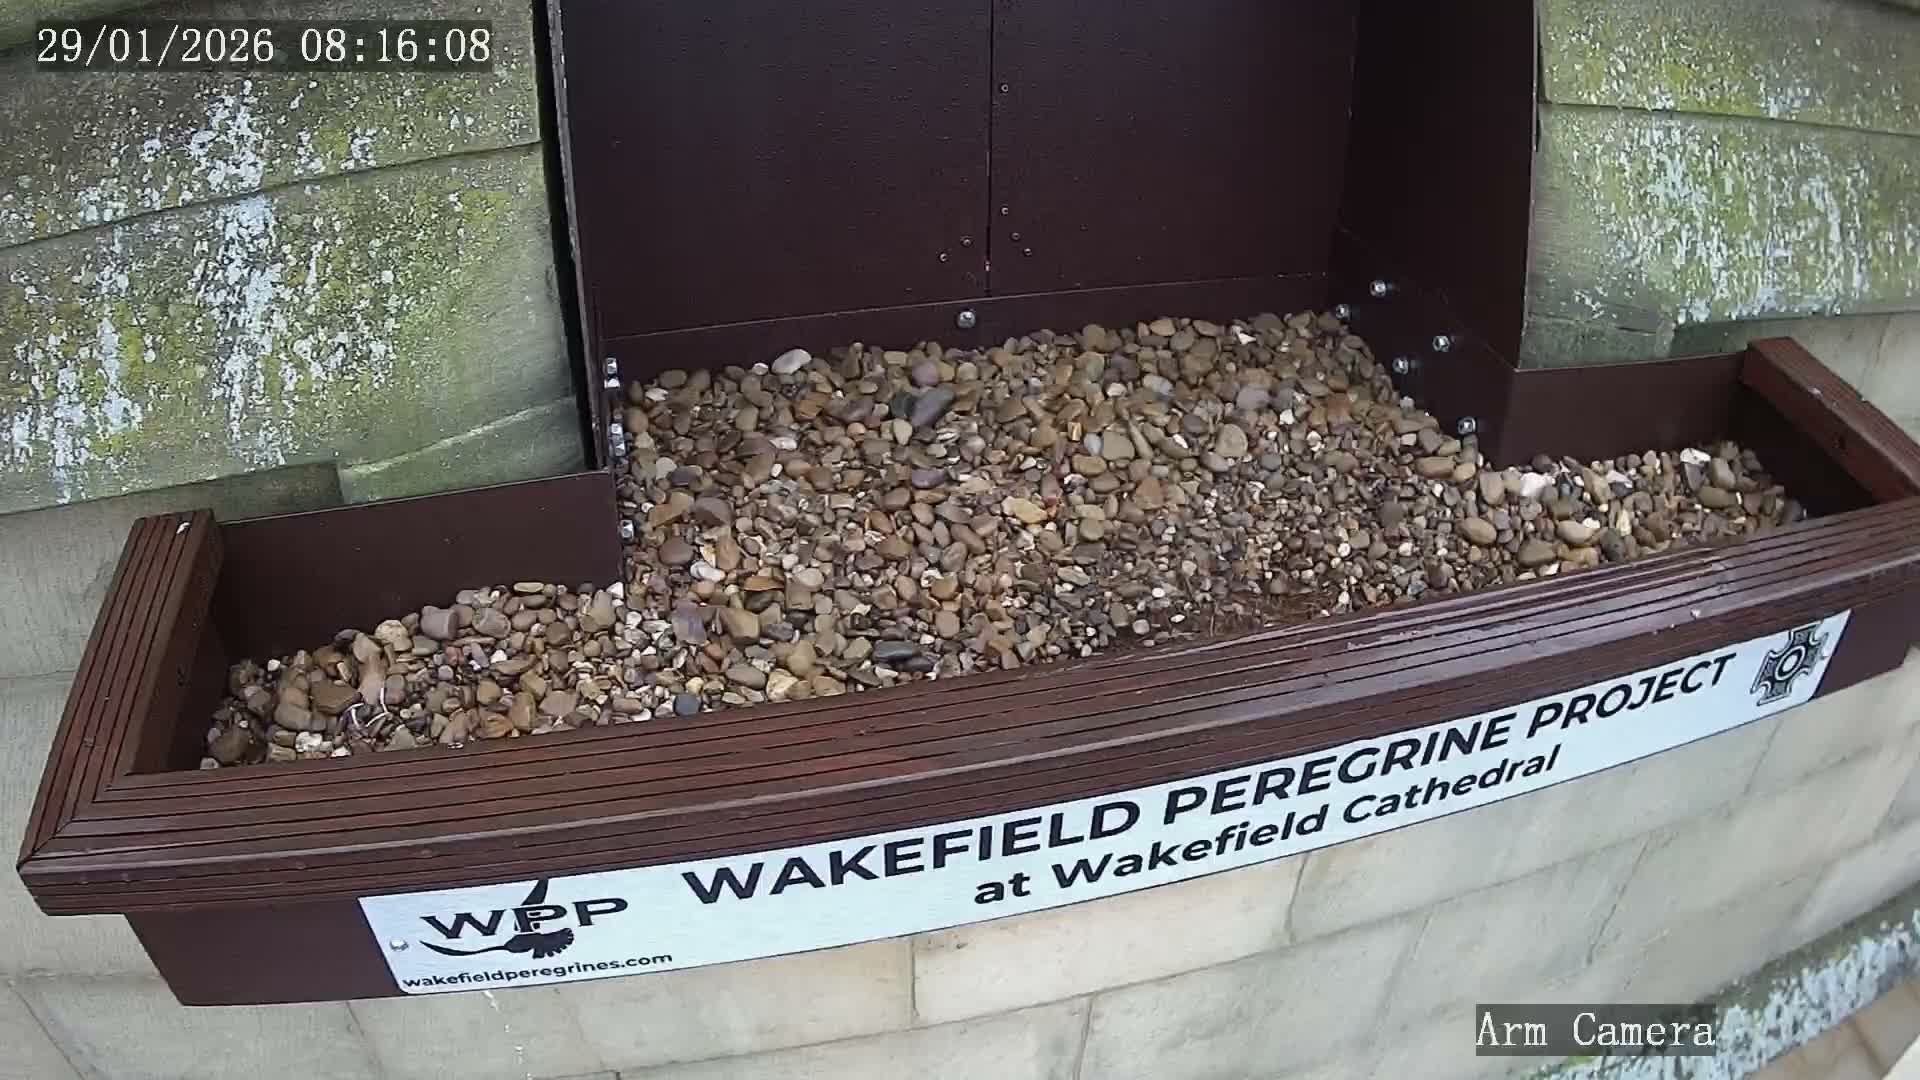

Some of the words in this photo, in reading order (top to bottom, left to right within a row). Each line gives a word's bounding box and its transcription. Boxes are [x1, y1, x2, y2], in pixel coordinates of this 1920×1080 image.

[682, 800, 1141, 905] WAKEFIELD
[1163, 712, 1517, 825] PEREGRINE
[1527, 652, 1737, 739] PROJECT
[974, 871, 1031, 905] at
[1051, 804, 1329, 889] Wakefield
[1343, 743, 1562, 824] Cathedral
[419, 897, 629, 940] WPP
[402, 952, 673, 988] wakefieldperegrines.com
